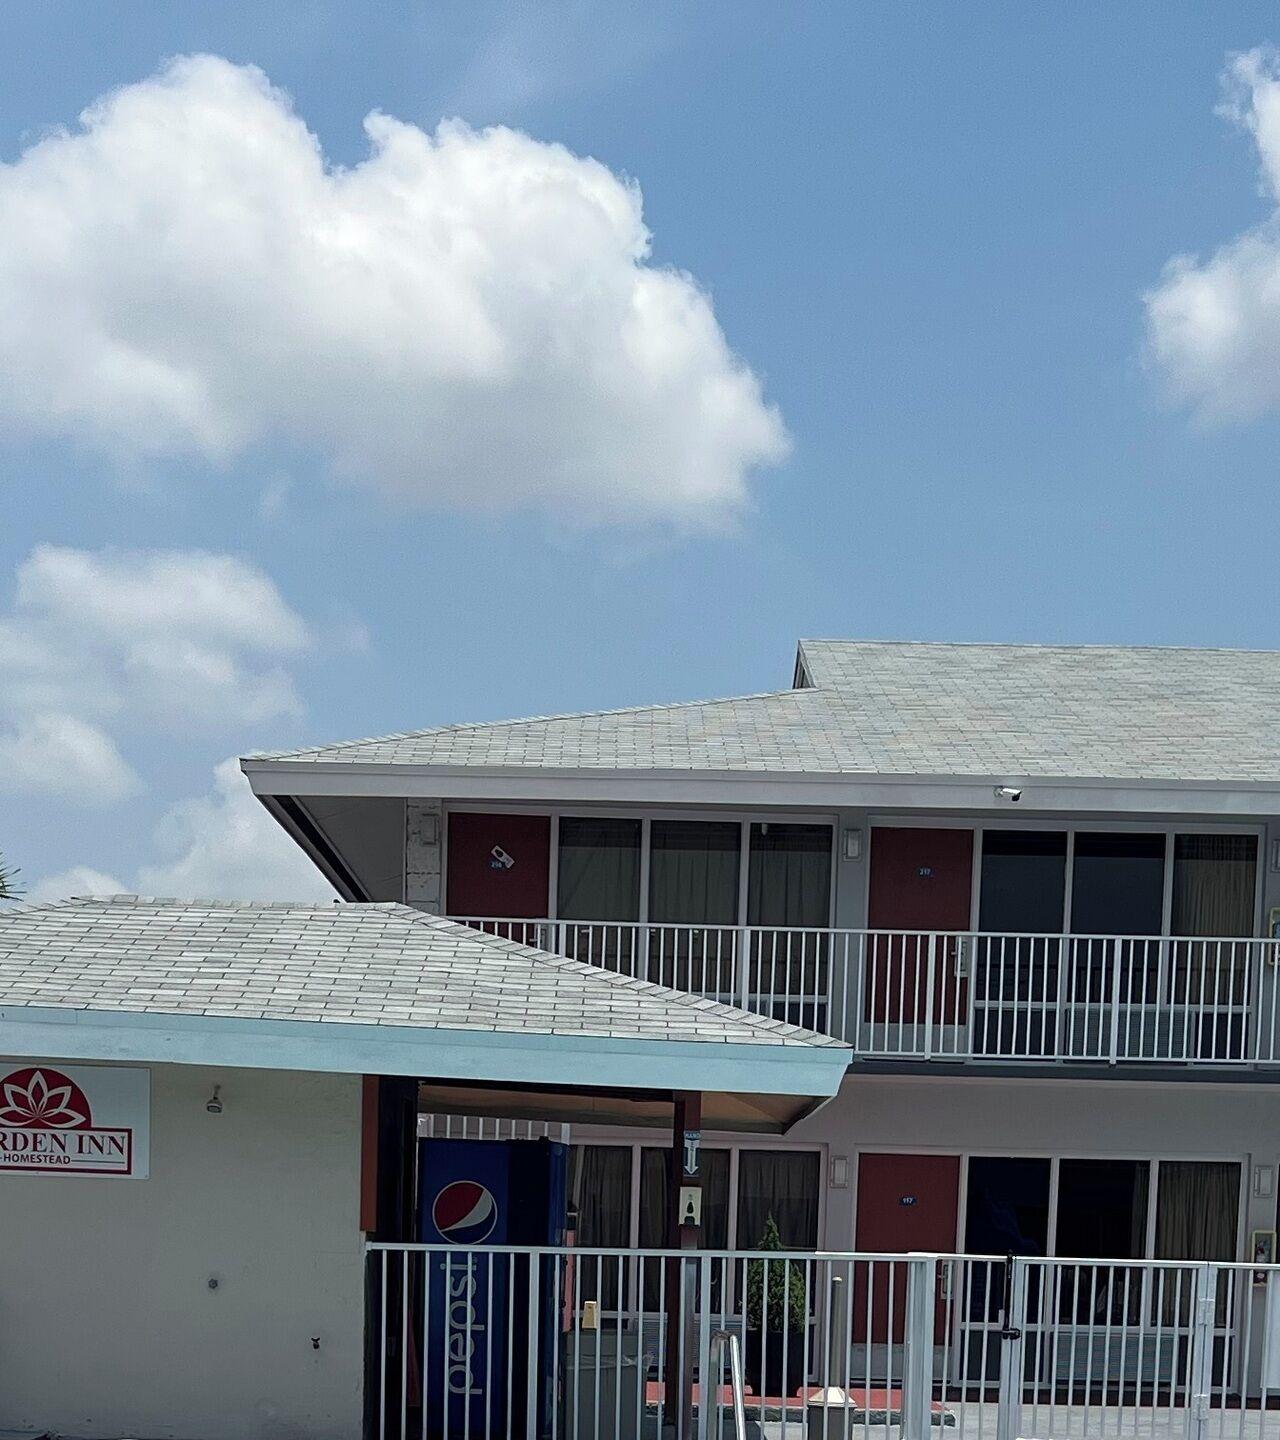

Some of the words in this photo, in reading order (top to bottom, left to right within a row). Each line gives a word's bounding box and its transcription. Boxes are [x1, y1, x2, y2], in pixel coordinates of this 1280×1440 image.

[77, 1134, 126, 1156] INN
[3, 1153, 71, 1165] HOMESTEAD
[439, 1263, 485, 1395] pepsi
